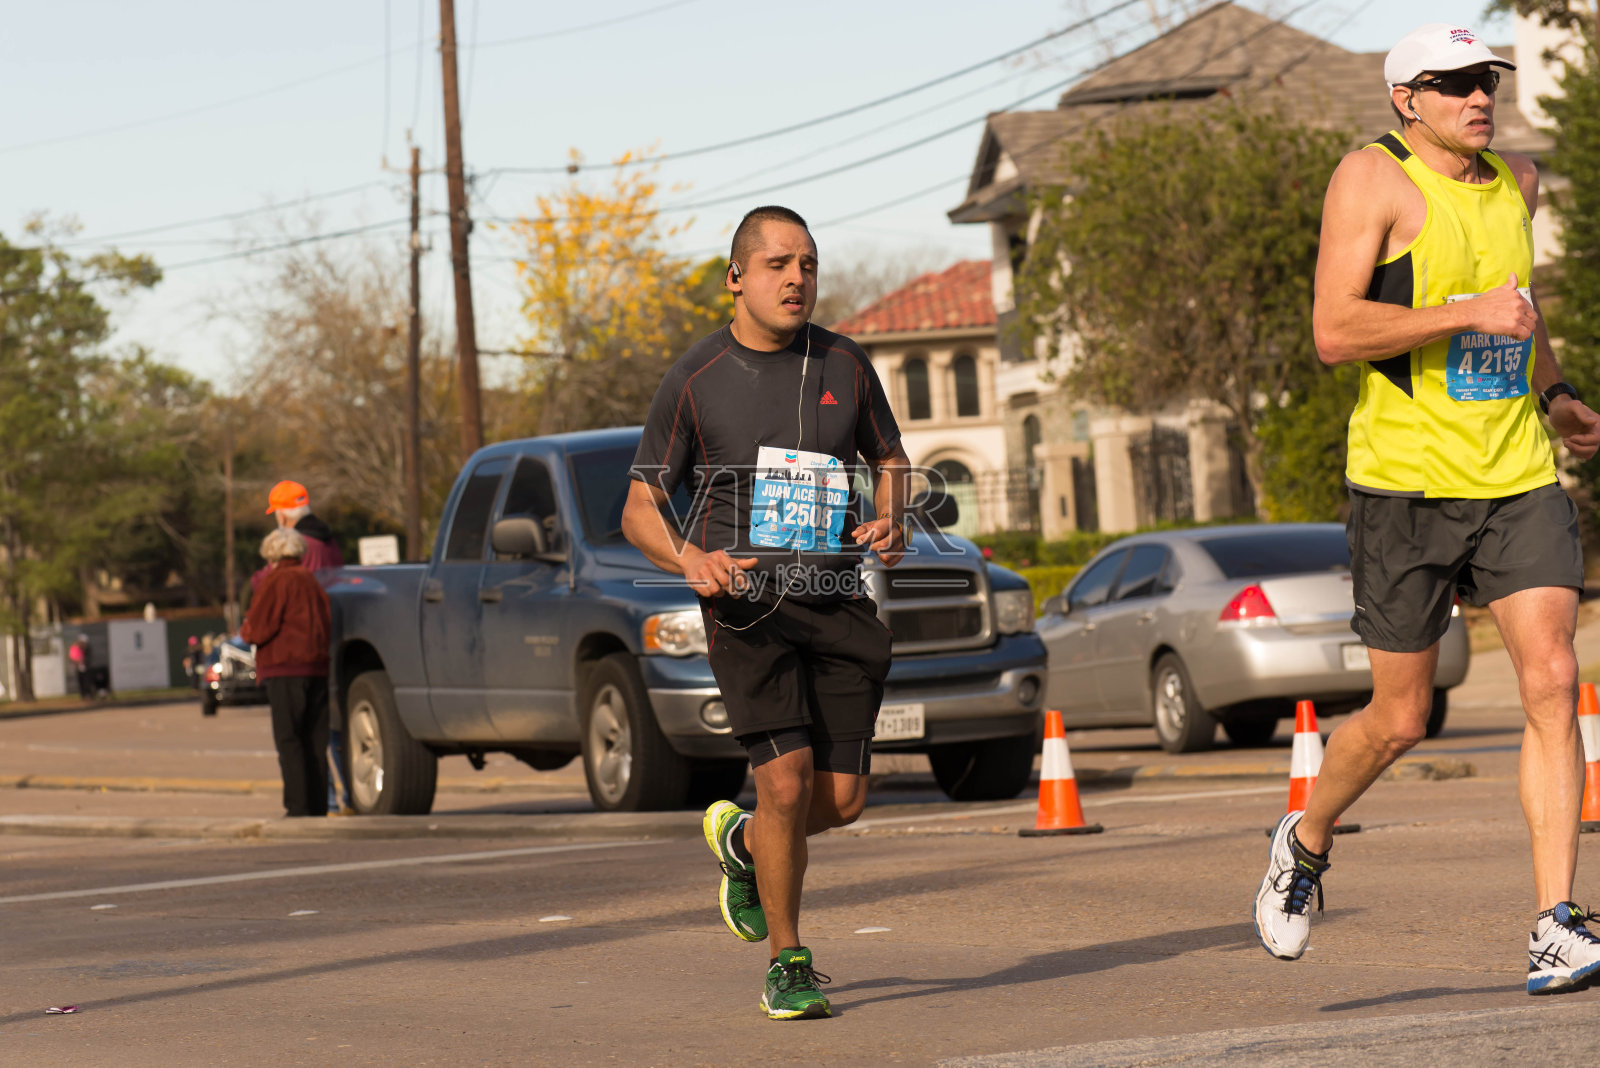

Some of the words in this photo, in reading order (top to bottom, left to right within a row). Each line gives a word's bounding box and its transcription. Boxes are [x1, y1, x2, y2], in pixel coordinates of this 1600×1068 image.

[1461, 334, 1490, 349] MARK
[1458, 351, 1472, 375] A
[1479, 346, 1523, 374] 2155
[761, 483, 791, 500] JUAN
[792, 487, 842, 505] ACEVEDO
[763, 499, 778, 523] A
[784, 501, 833, 530] 2508
